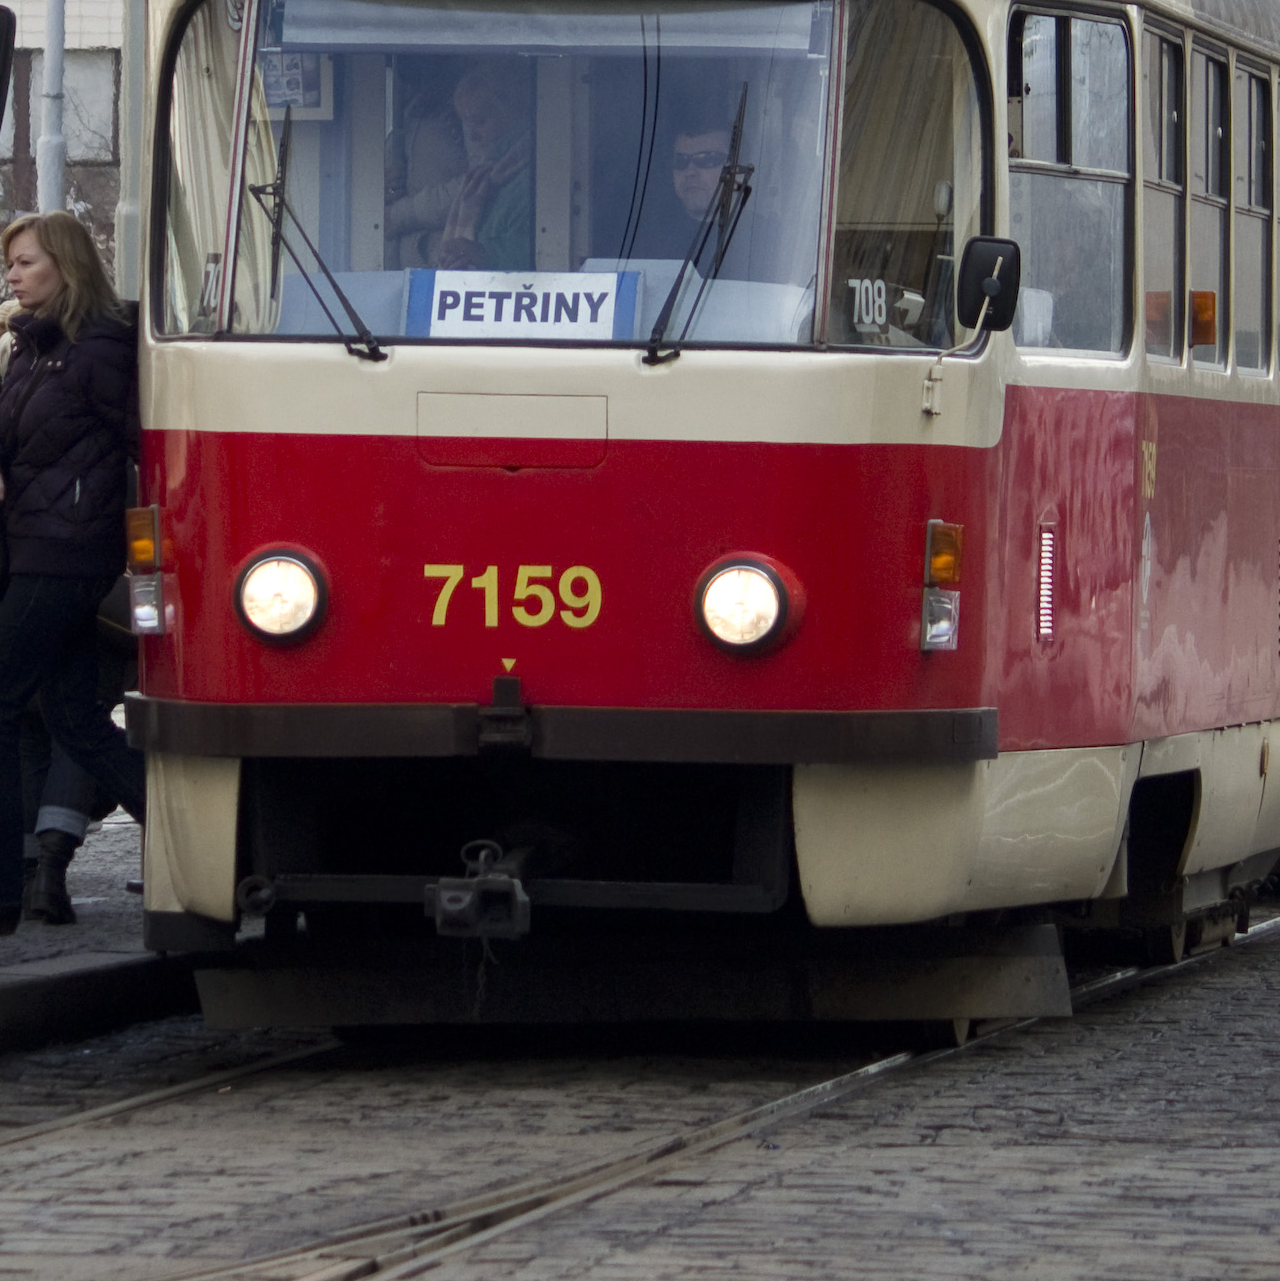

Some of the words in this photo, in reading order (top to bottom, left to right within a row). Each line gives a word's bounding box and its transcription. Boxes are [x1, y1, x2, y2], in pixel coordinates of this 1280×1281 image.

[436, 285, 609, 325] PETŘINY
[848, 278, 887, 325] 708
[423, 564, 603, 629] 7159
